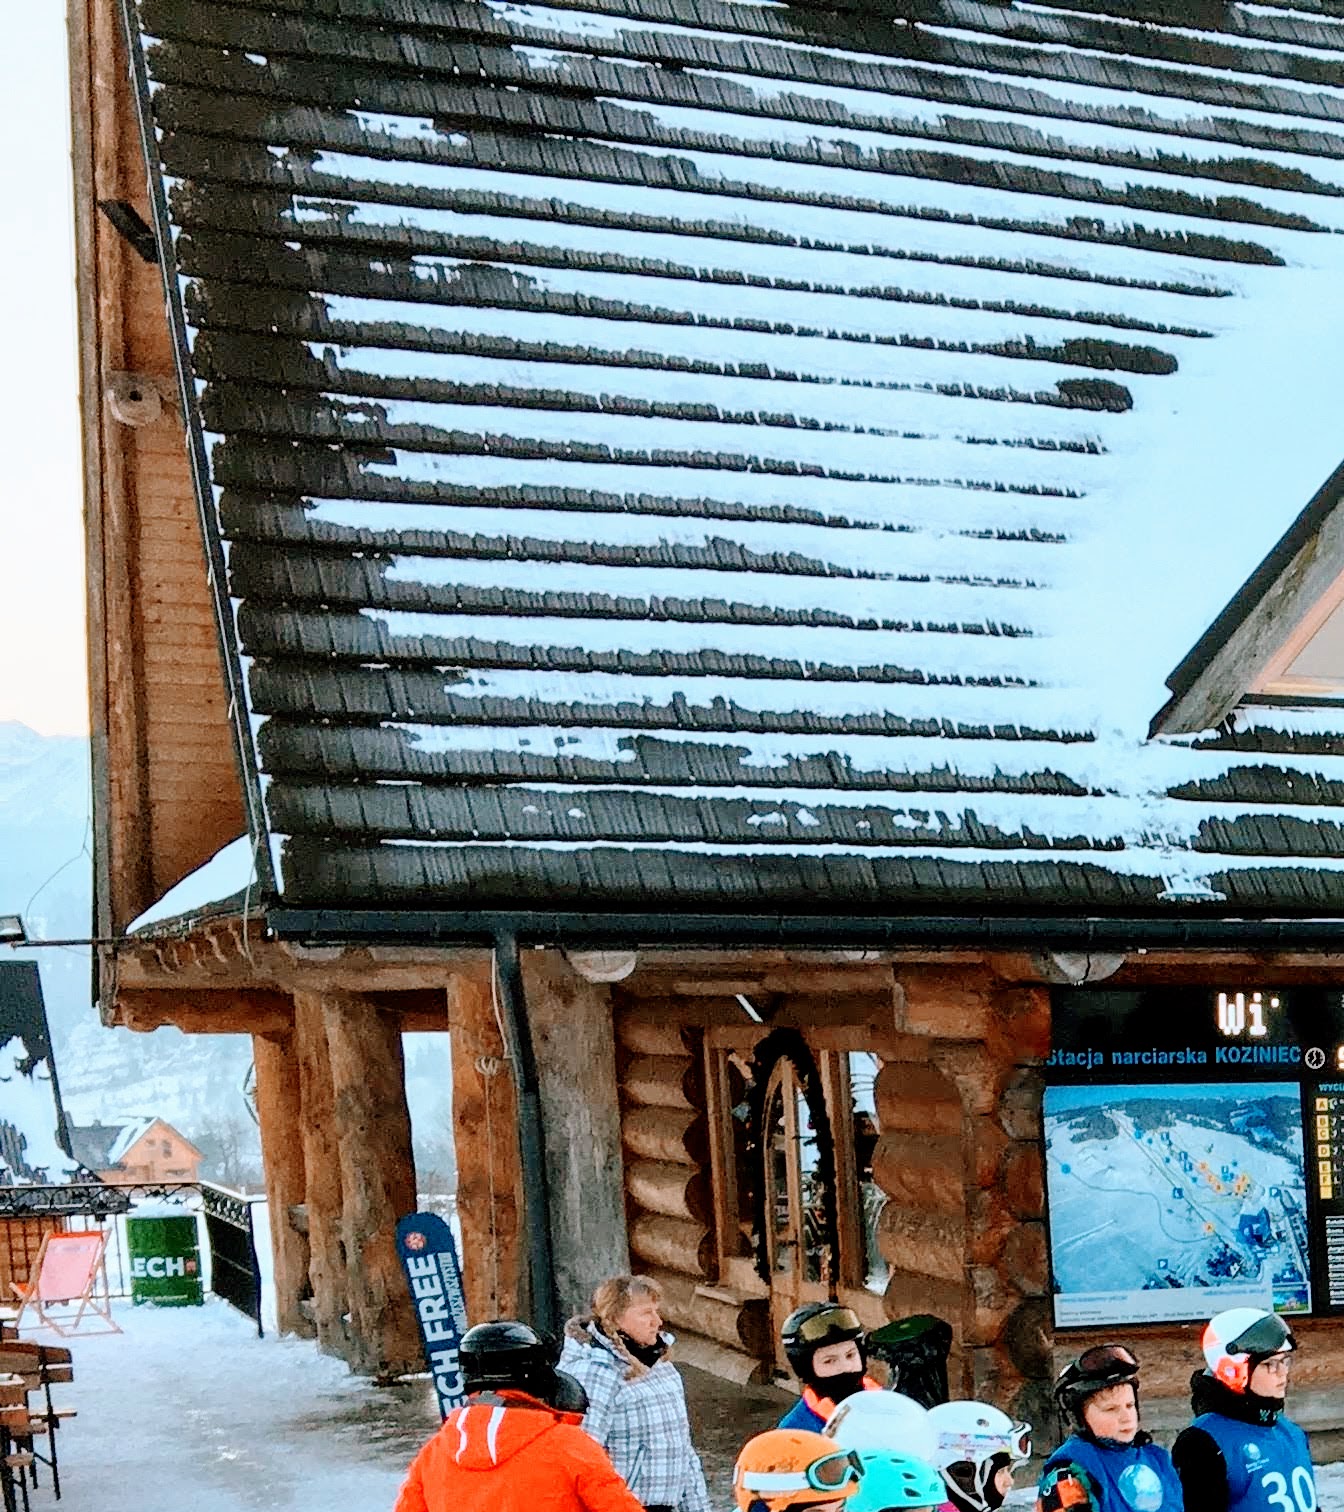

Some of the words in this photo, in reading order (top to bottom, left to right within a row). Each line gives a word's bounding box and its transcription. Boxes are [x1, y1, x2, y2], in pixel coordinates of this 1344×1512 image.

[1047, 1048, 1104, 1069] Stacja
[1112, 1047, 1207, 1065] narciarska
[1215, 1046, 1300, 1063] KOZINIEC
[132, 1256, 185, 1278] ECH
[407, 1252, 456, 1343] FREE
[431, 1348, 468, 1417] ECH
